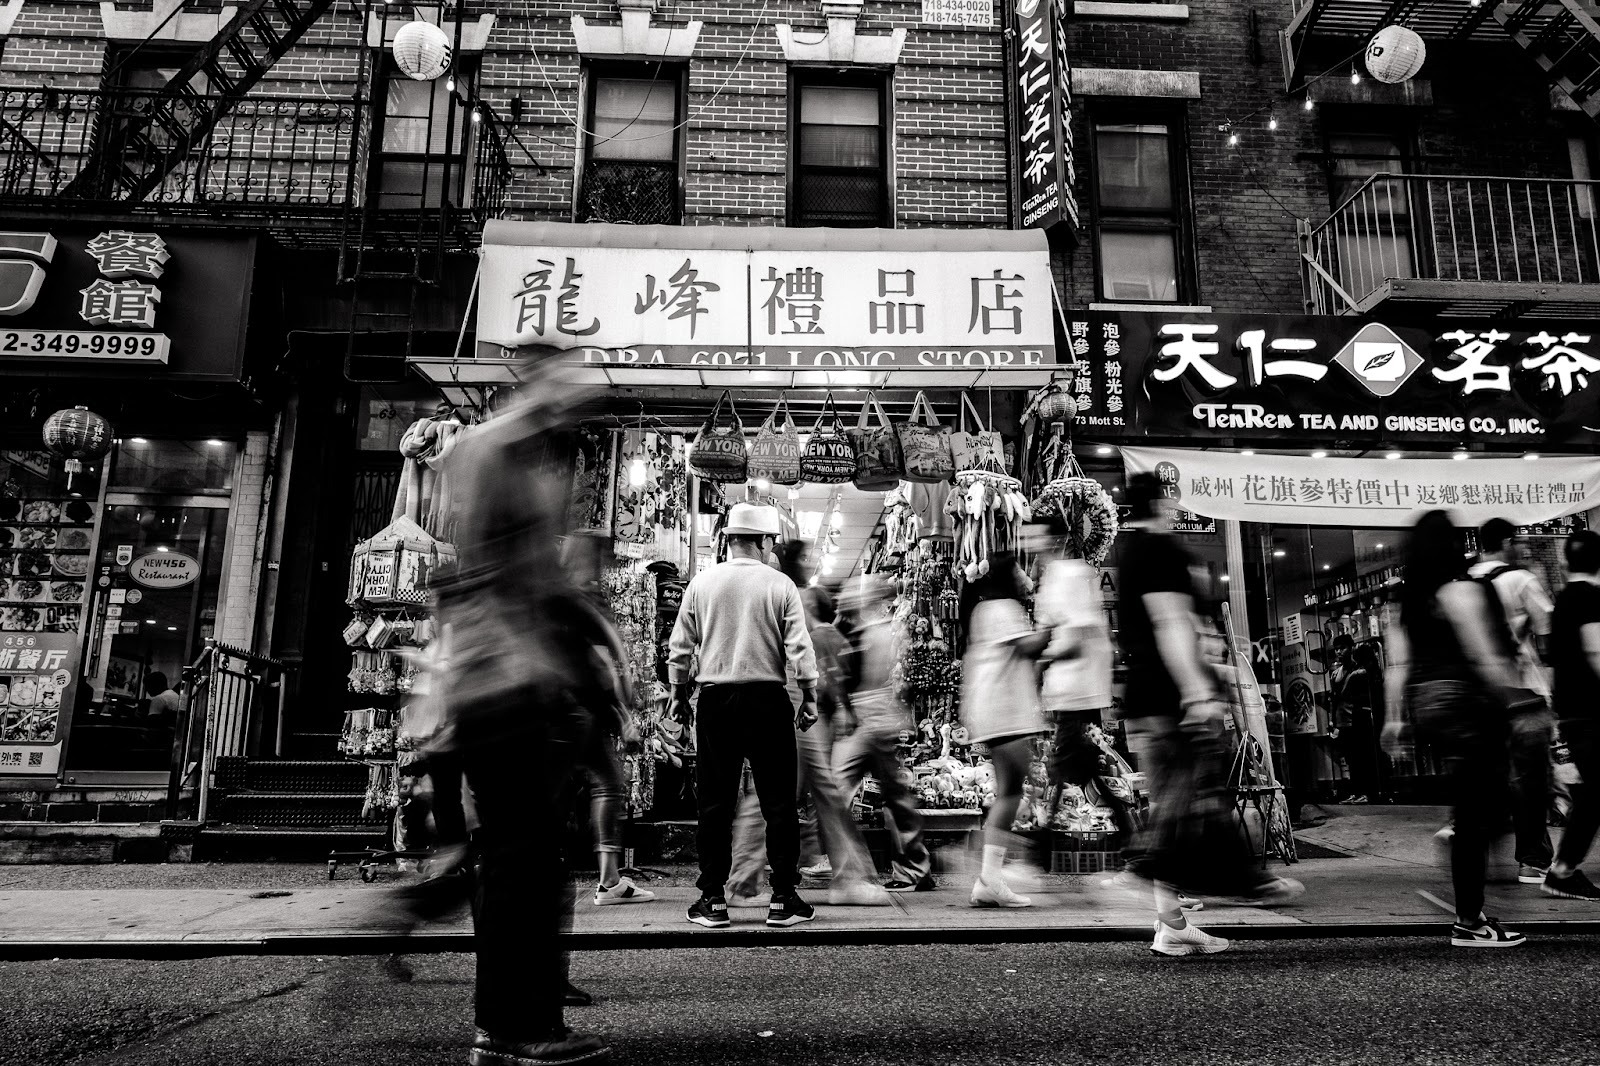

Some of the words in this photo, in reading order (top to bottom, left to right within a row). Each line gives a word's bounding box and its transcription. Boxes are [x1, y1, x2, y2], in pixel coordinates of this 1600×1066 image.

[924, 0, 990, 11] 718-434-0020
[924, 12, 990, 24] 718-745-7475
[1018, 18, 1055, 185] 天仁茗茶
[1045, 181, 1058, 197] TEA
[1023, 197, 1058, 226] GINSENG
[79, 230, 168, 327] 餐館
[2, 332, 155, 356] 2-349-9999
[379, 409, 397, 419] 69
[1192, 403, 1295, 429] TenRen
[1299, 414, 1336, 430] TEA
[1340, 415, 1379, 431] AND
[1385, 416, 1465, 432] GINSENG
[1508, 418, 1546, 434] INC.
[1075, 416, 1087, 425] 73
[1089, 416, 1111, 425] Mott
[1112, 416, 1126, 426] St.
[774, 442, 800, 457] YOR
[1240, 474, 1410, 506] 花旗參特價中
[1165, 522, 1203, 530] MPORIUM
[1551, 527, 1574, 535] TEA
[138, 568, 190, 580] Restaurant
[370, 564, 392, 574] CITY
[365, 575, 390, 586] YORK
[367, 586, 388, 596] NEW
[5, 636, 35, 647] 456
